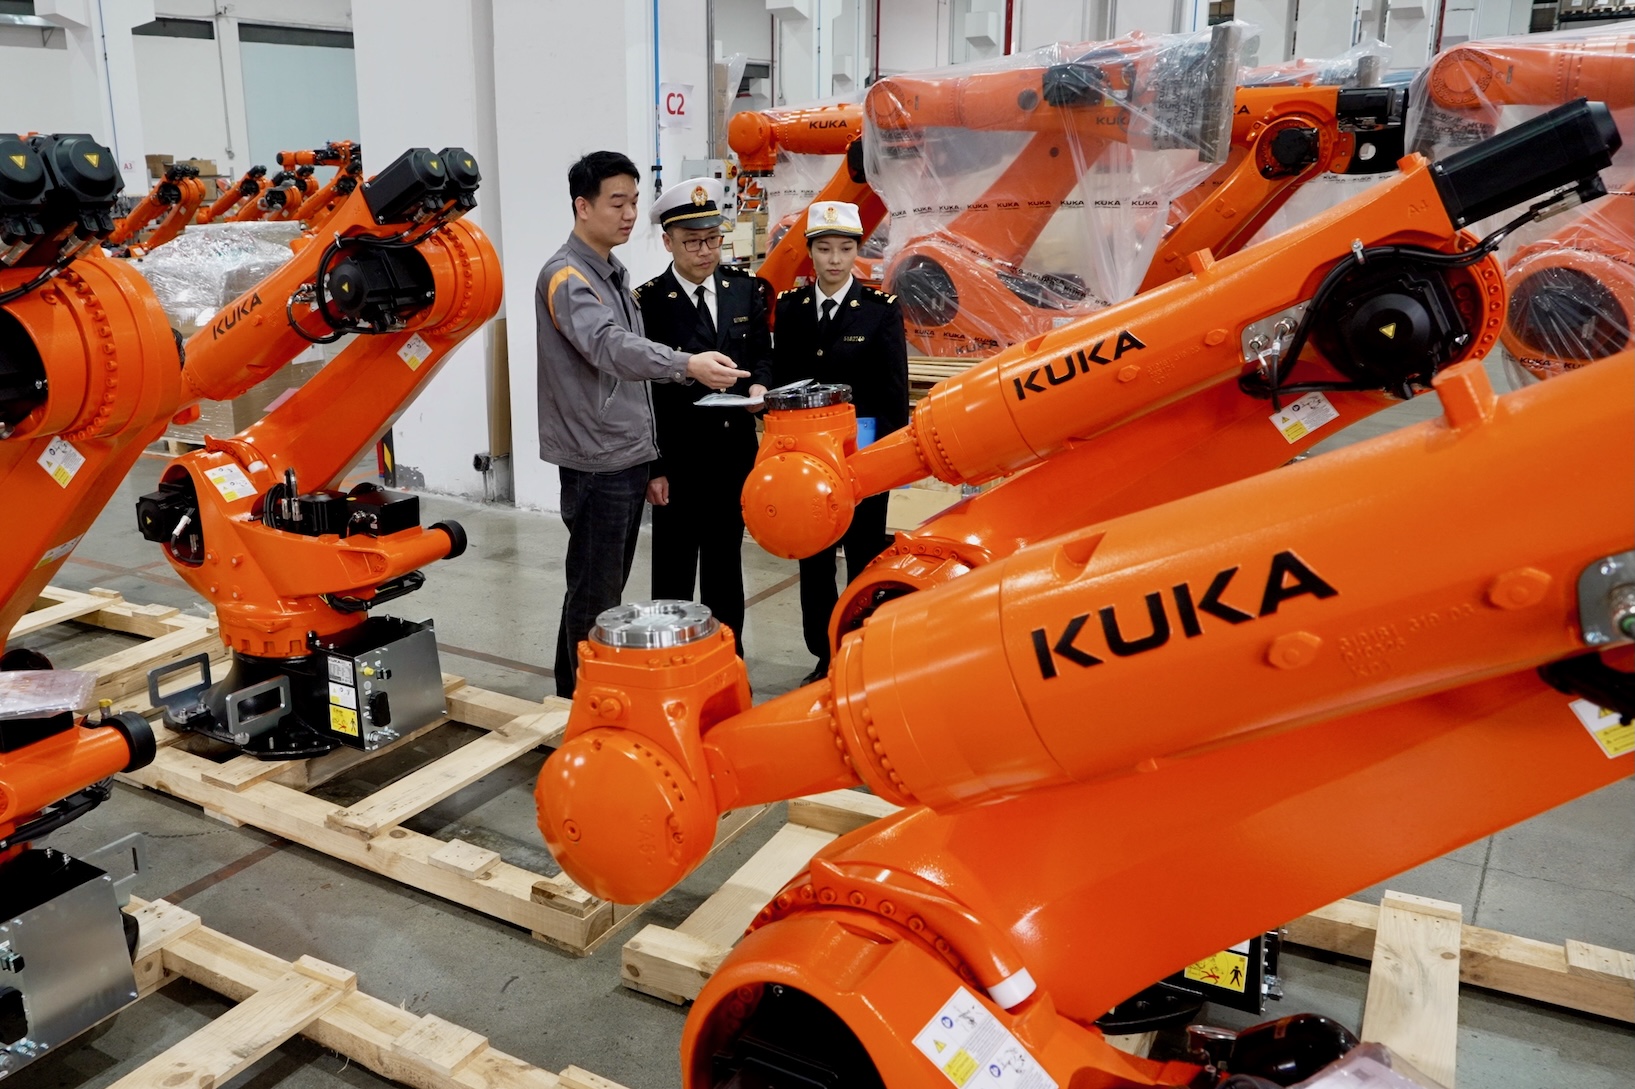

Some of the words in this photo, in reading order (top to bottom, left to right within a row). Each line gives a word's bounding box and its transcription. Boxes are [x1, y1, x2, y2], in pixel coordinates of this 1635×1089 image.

[666, 92, 685, 115] C2
[809, 120, 848, 129] KUKA
[1096, 117, 1130, 126] KUK
[213, 292, 263, 341] KUKA
[943, 332, 966, 340] KUKA
[1013, 330, 1147, 401] KUKA
[1519, 357, 1551, 367] KUKA
[1031, 549, 1339, 680] KUKA
